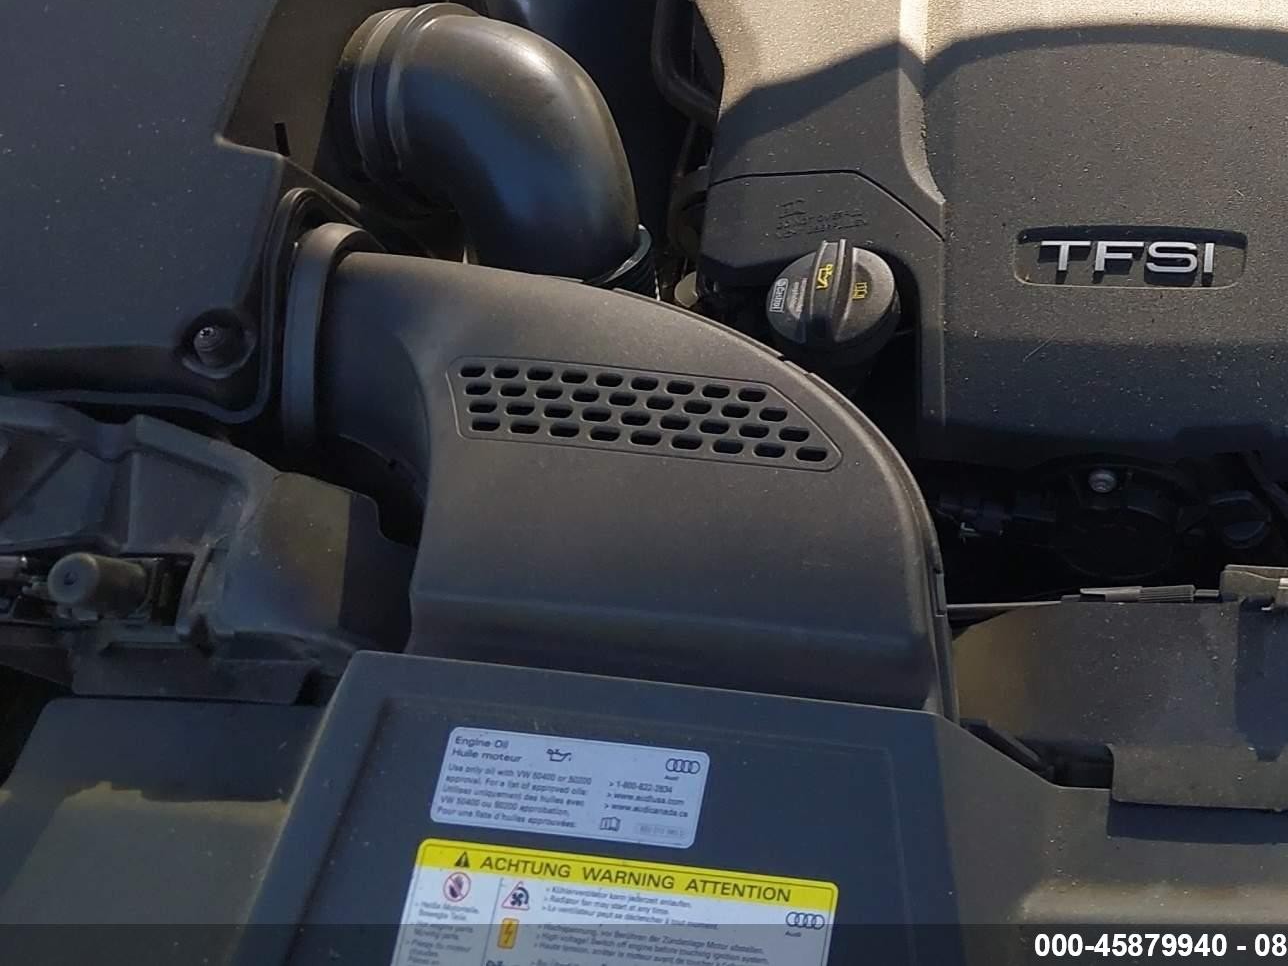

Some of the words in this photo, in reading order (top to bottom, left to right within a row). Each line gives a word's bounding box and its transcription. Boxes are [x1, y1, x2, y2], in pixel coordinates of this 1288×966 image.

[1041, 240, 1215, 274] TFSI
[455, 736, 491, 748] Engine
[494, 740, 510, 749] Oil
[452, 748, 478, 758] Huile
[481, 751, 522, 763] moteur
[517, 770, 531, 778] VW
[480, 856, 571, 879] ACHTUNG
[582, 866, 675, 890] WARNING
[684, 878, 791, 902] ATTENTION
[785, 930, 802, 938] Audi
